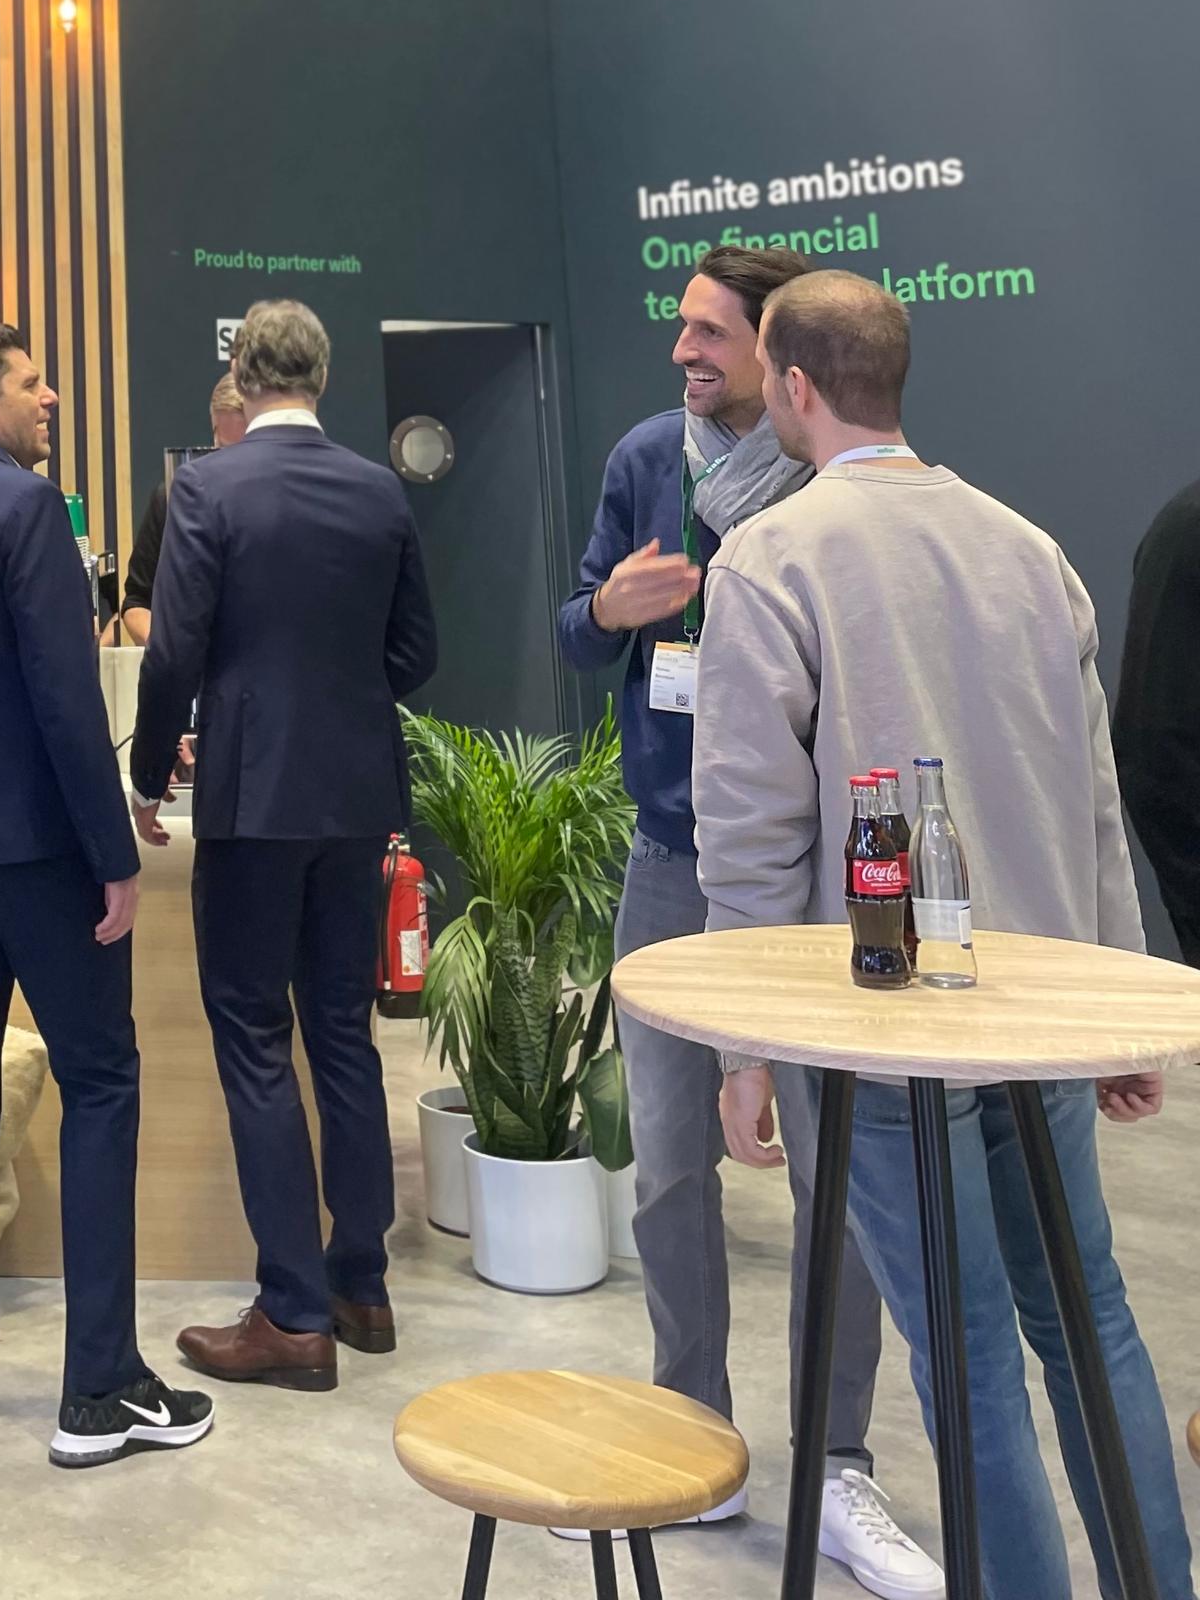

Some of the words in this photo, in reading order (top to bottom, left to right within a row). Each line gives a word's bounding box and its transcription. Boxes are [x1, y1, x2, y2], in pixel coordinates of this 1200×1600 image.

[638, 176, 760, 220] Infinite
[767, 155, 964, 206] ambitions
[194, 248, 244, 269] Proud
[247, 253, 264, 270] to
[267, 255, 326, 275] partner
[328, 256, 362, 273] with
[642, 236, 712, 270] One
[720, 211, 879, 257] financial
